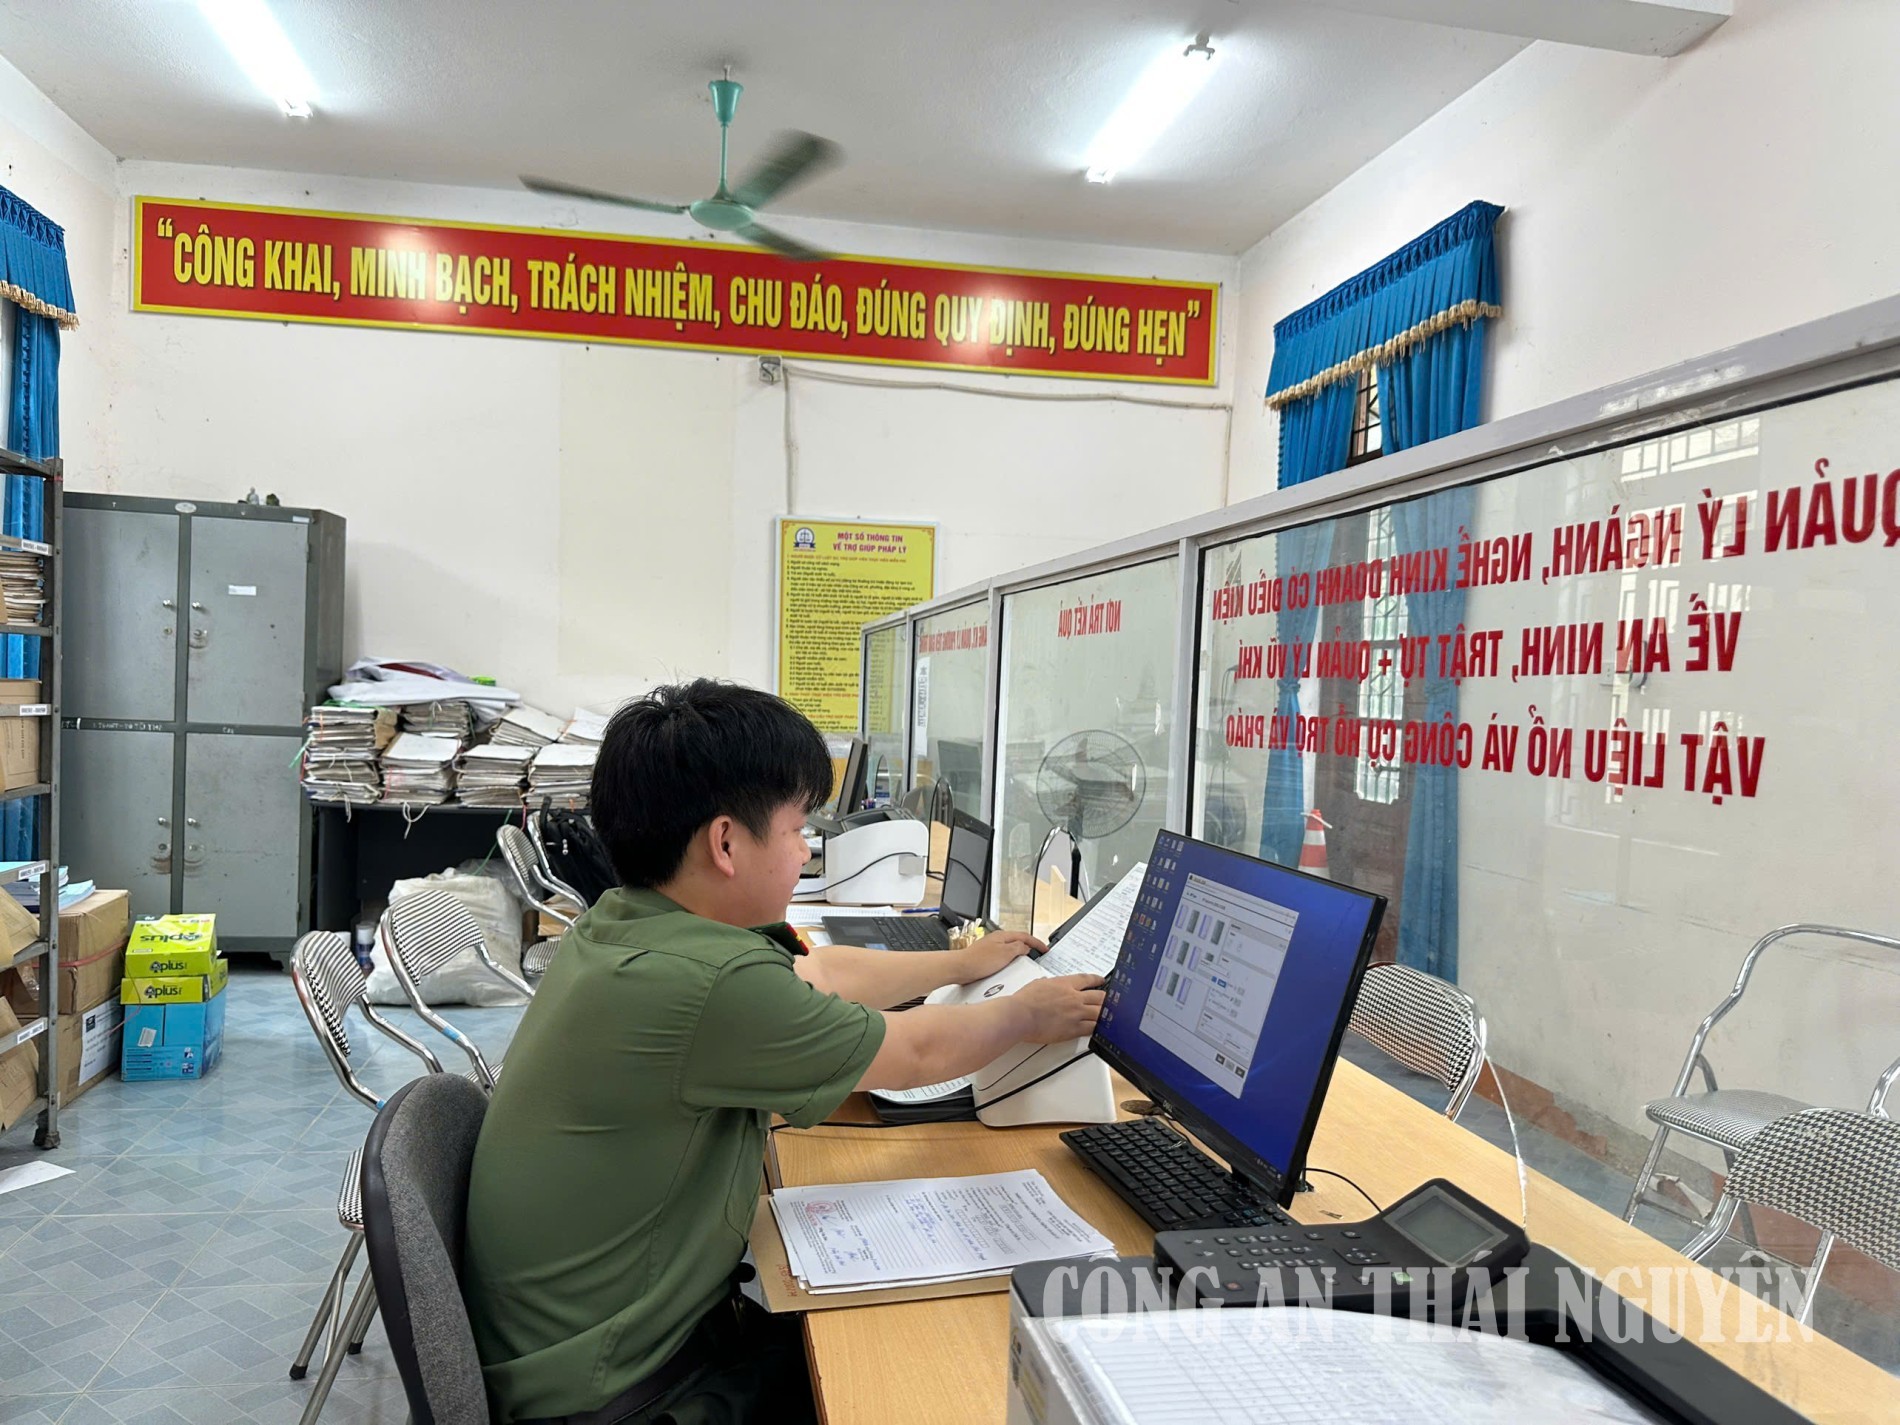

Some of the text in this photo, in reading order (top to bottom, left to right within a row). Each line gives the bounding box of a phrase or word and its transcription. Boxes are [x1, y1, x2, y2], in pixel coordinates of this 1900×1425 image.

[264, 240, 341, 301] KHAI,
[351, 246, 426, 301] MINH
[436, 252, 518, 314] BẠCH,
[527, 252, 615, 315] TRÁCH
[624, 260, 721, 331] NHIỆM,
[730, 276, 781, 328] CHU
[790, 274, 848, 339] ĐÁO,
[856, 278, 926, 338] ĐÚNG
[934, 293, 981, 346] QUY
[989, 297, 1056, 357] ĐỊNH,
[1062, 296, 1130, 354] ĐÚNG
[892, 533, 903, 543] TIN
